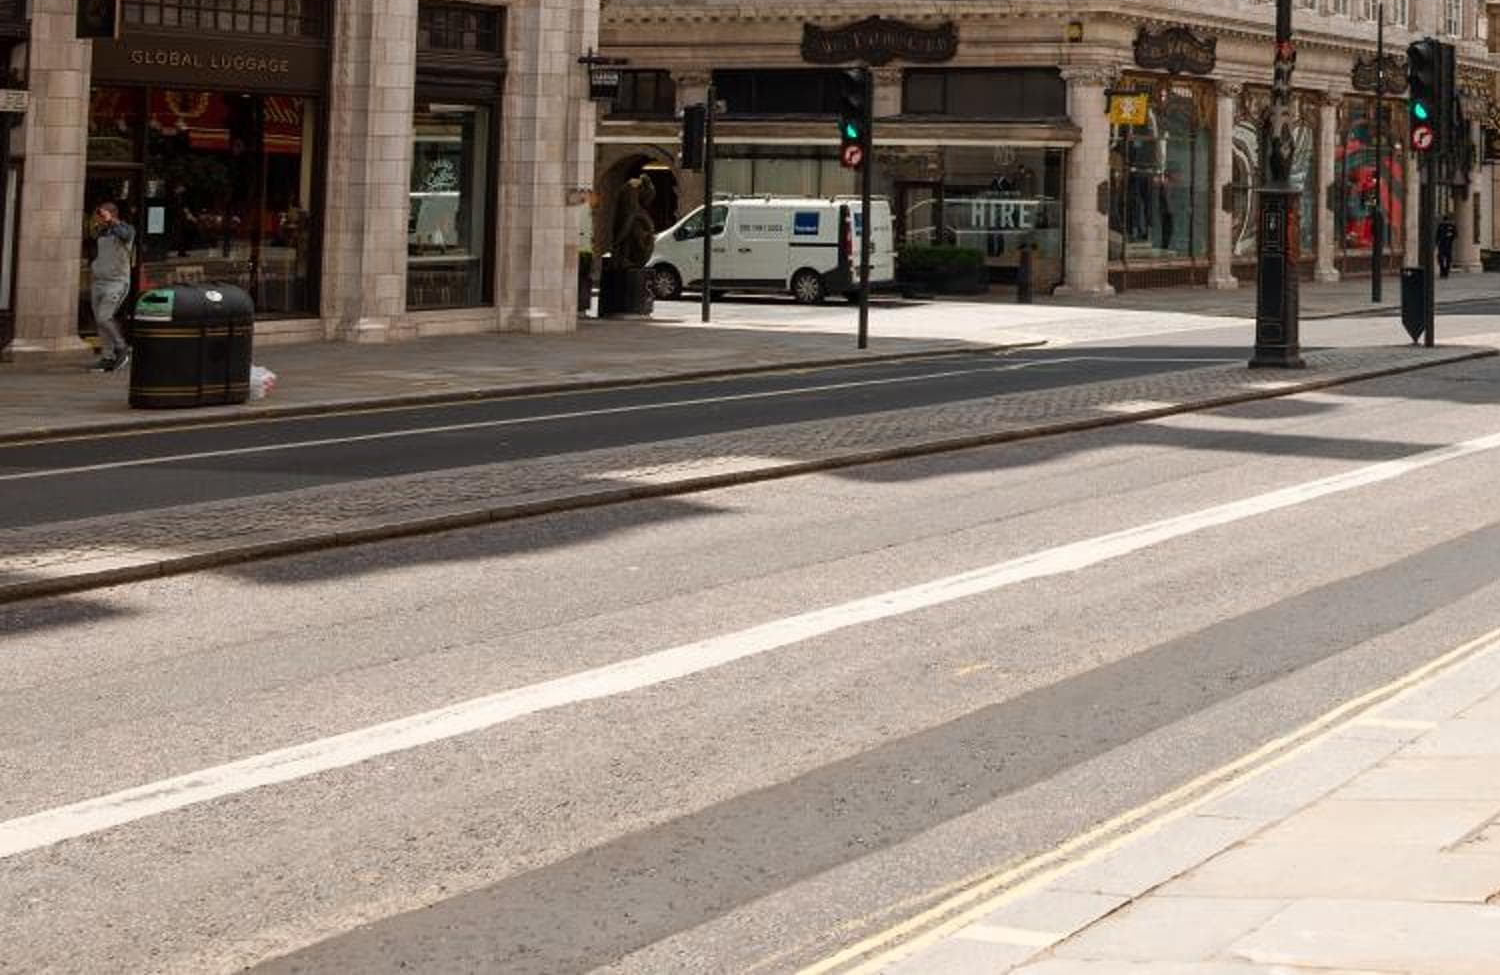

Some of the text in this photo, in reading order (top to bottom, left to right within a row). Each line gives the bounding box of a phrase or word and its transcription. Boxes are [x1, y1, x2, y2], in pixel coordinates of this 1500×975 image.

[131, 50, 289, 73] GLOBAL LUGGAGE
[971, 199, 1033, 228] HIRE
